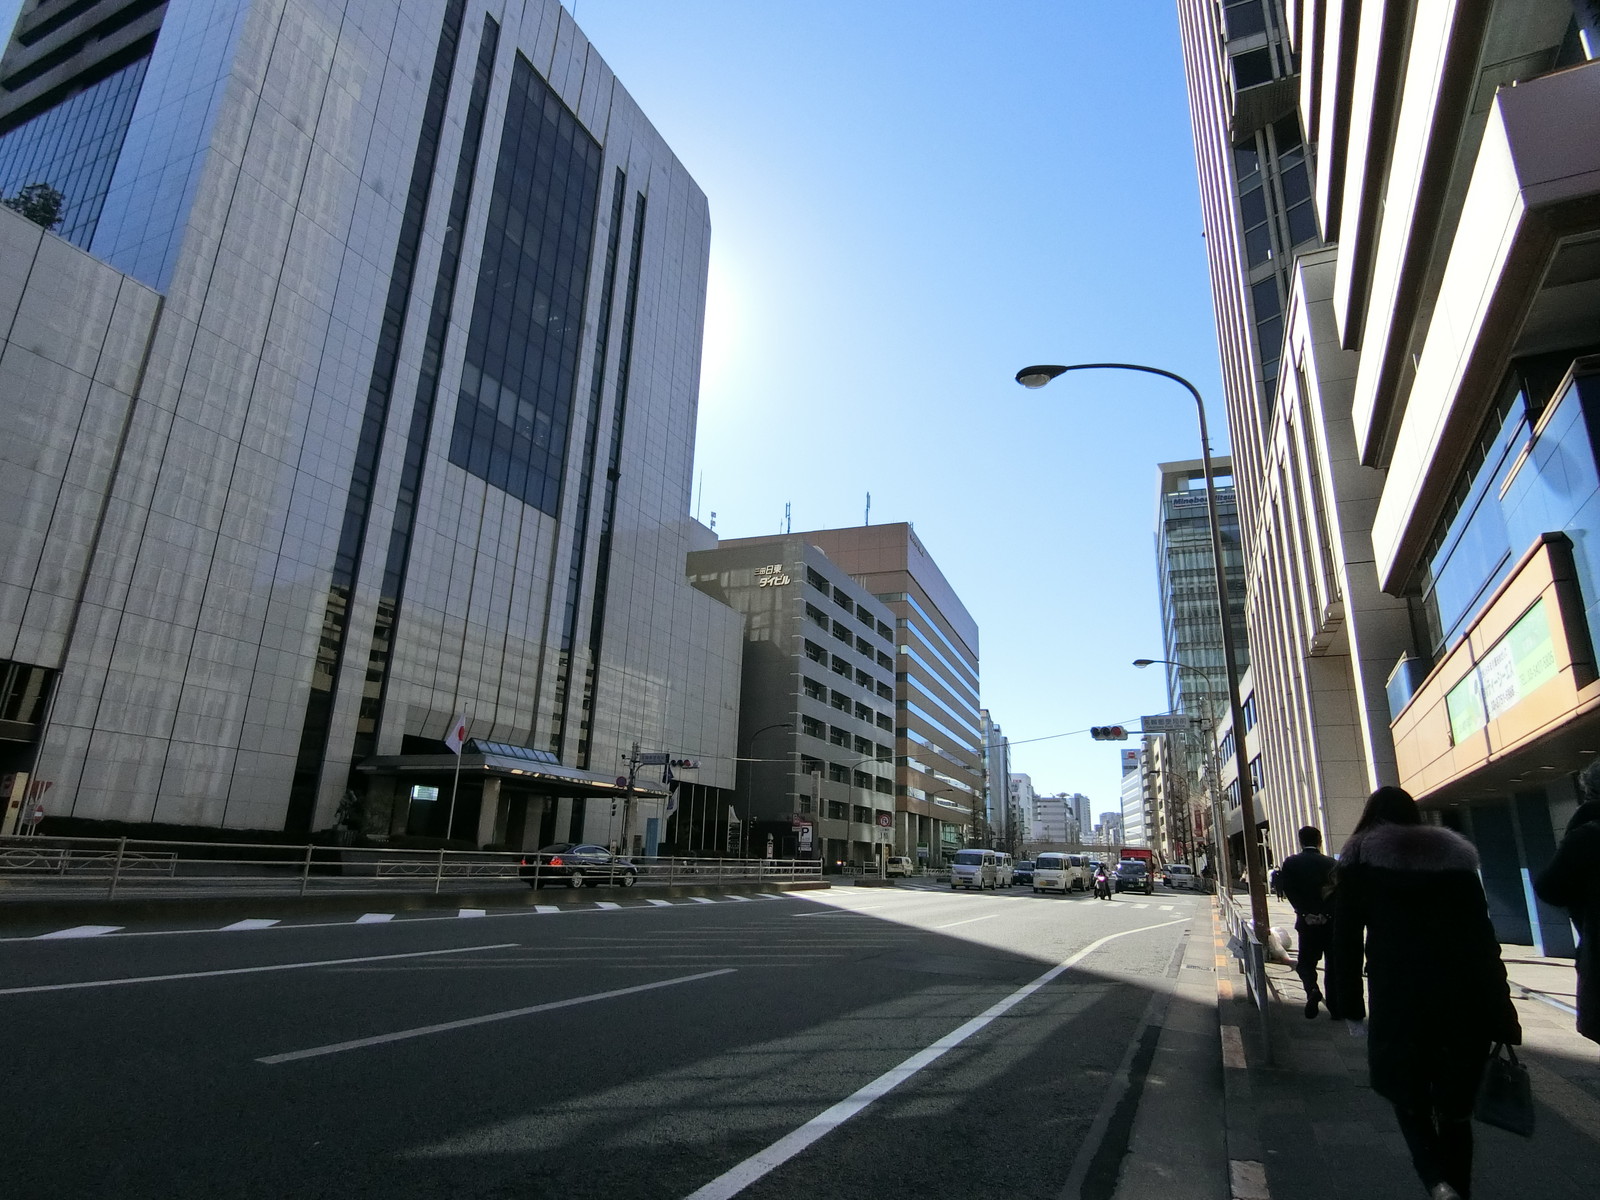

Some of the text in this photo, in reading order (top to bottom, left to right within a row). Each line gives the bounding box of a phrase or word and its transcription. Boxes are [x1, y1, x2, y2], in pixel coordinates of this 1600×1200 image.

[754, 564, 783, 576] 三田日東
[759, 573, 791, 587] ダイビル
[801, 827, 809, 836] P
